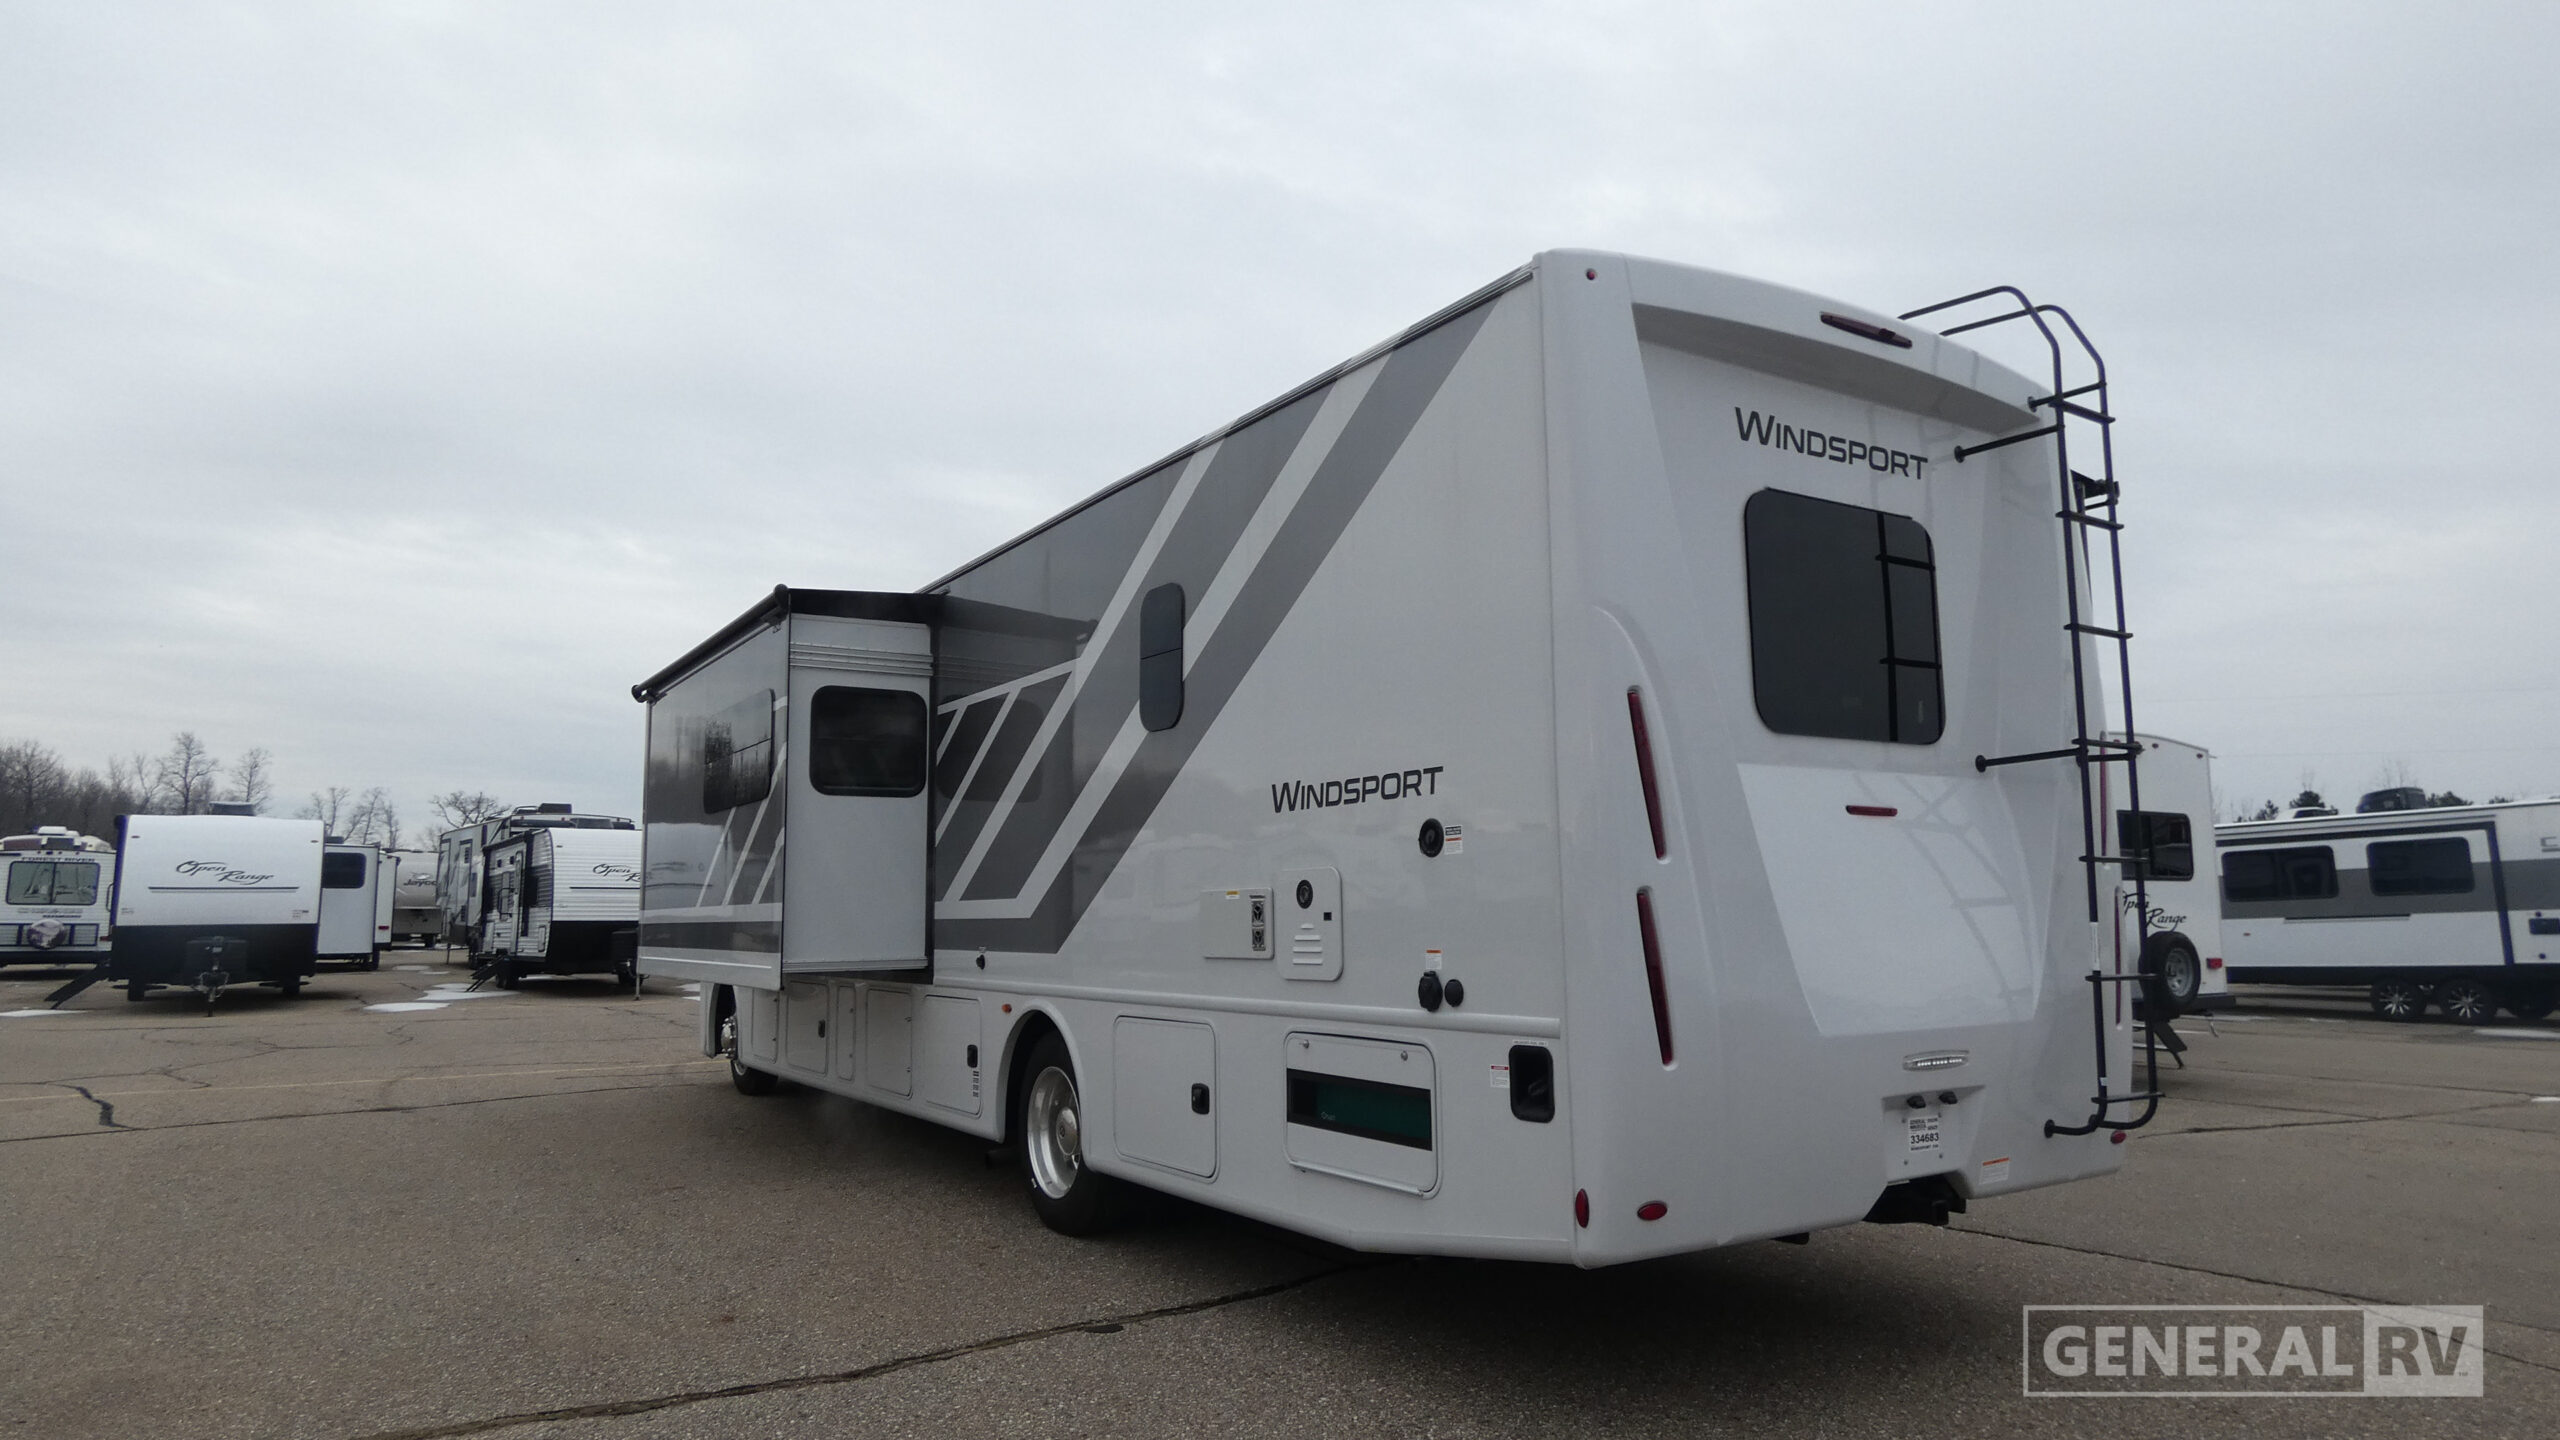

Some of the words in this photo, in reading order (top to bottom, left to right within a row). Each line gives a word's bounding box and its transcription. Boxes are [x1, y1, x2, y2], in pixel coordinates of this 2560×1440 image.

[1734, 406, 1929, 480] WINDSPORT
[1271, 766, 1444, 813] WINDSPORT
[176, 861, 229, 876] Open
[593, 863, 632, 877] Open
[215, 871, 275, 885] Range
[1910, 1132, 1939, 1144] 334683
